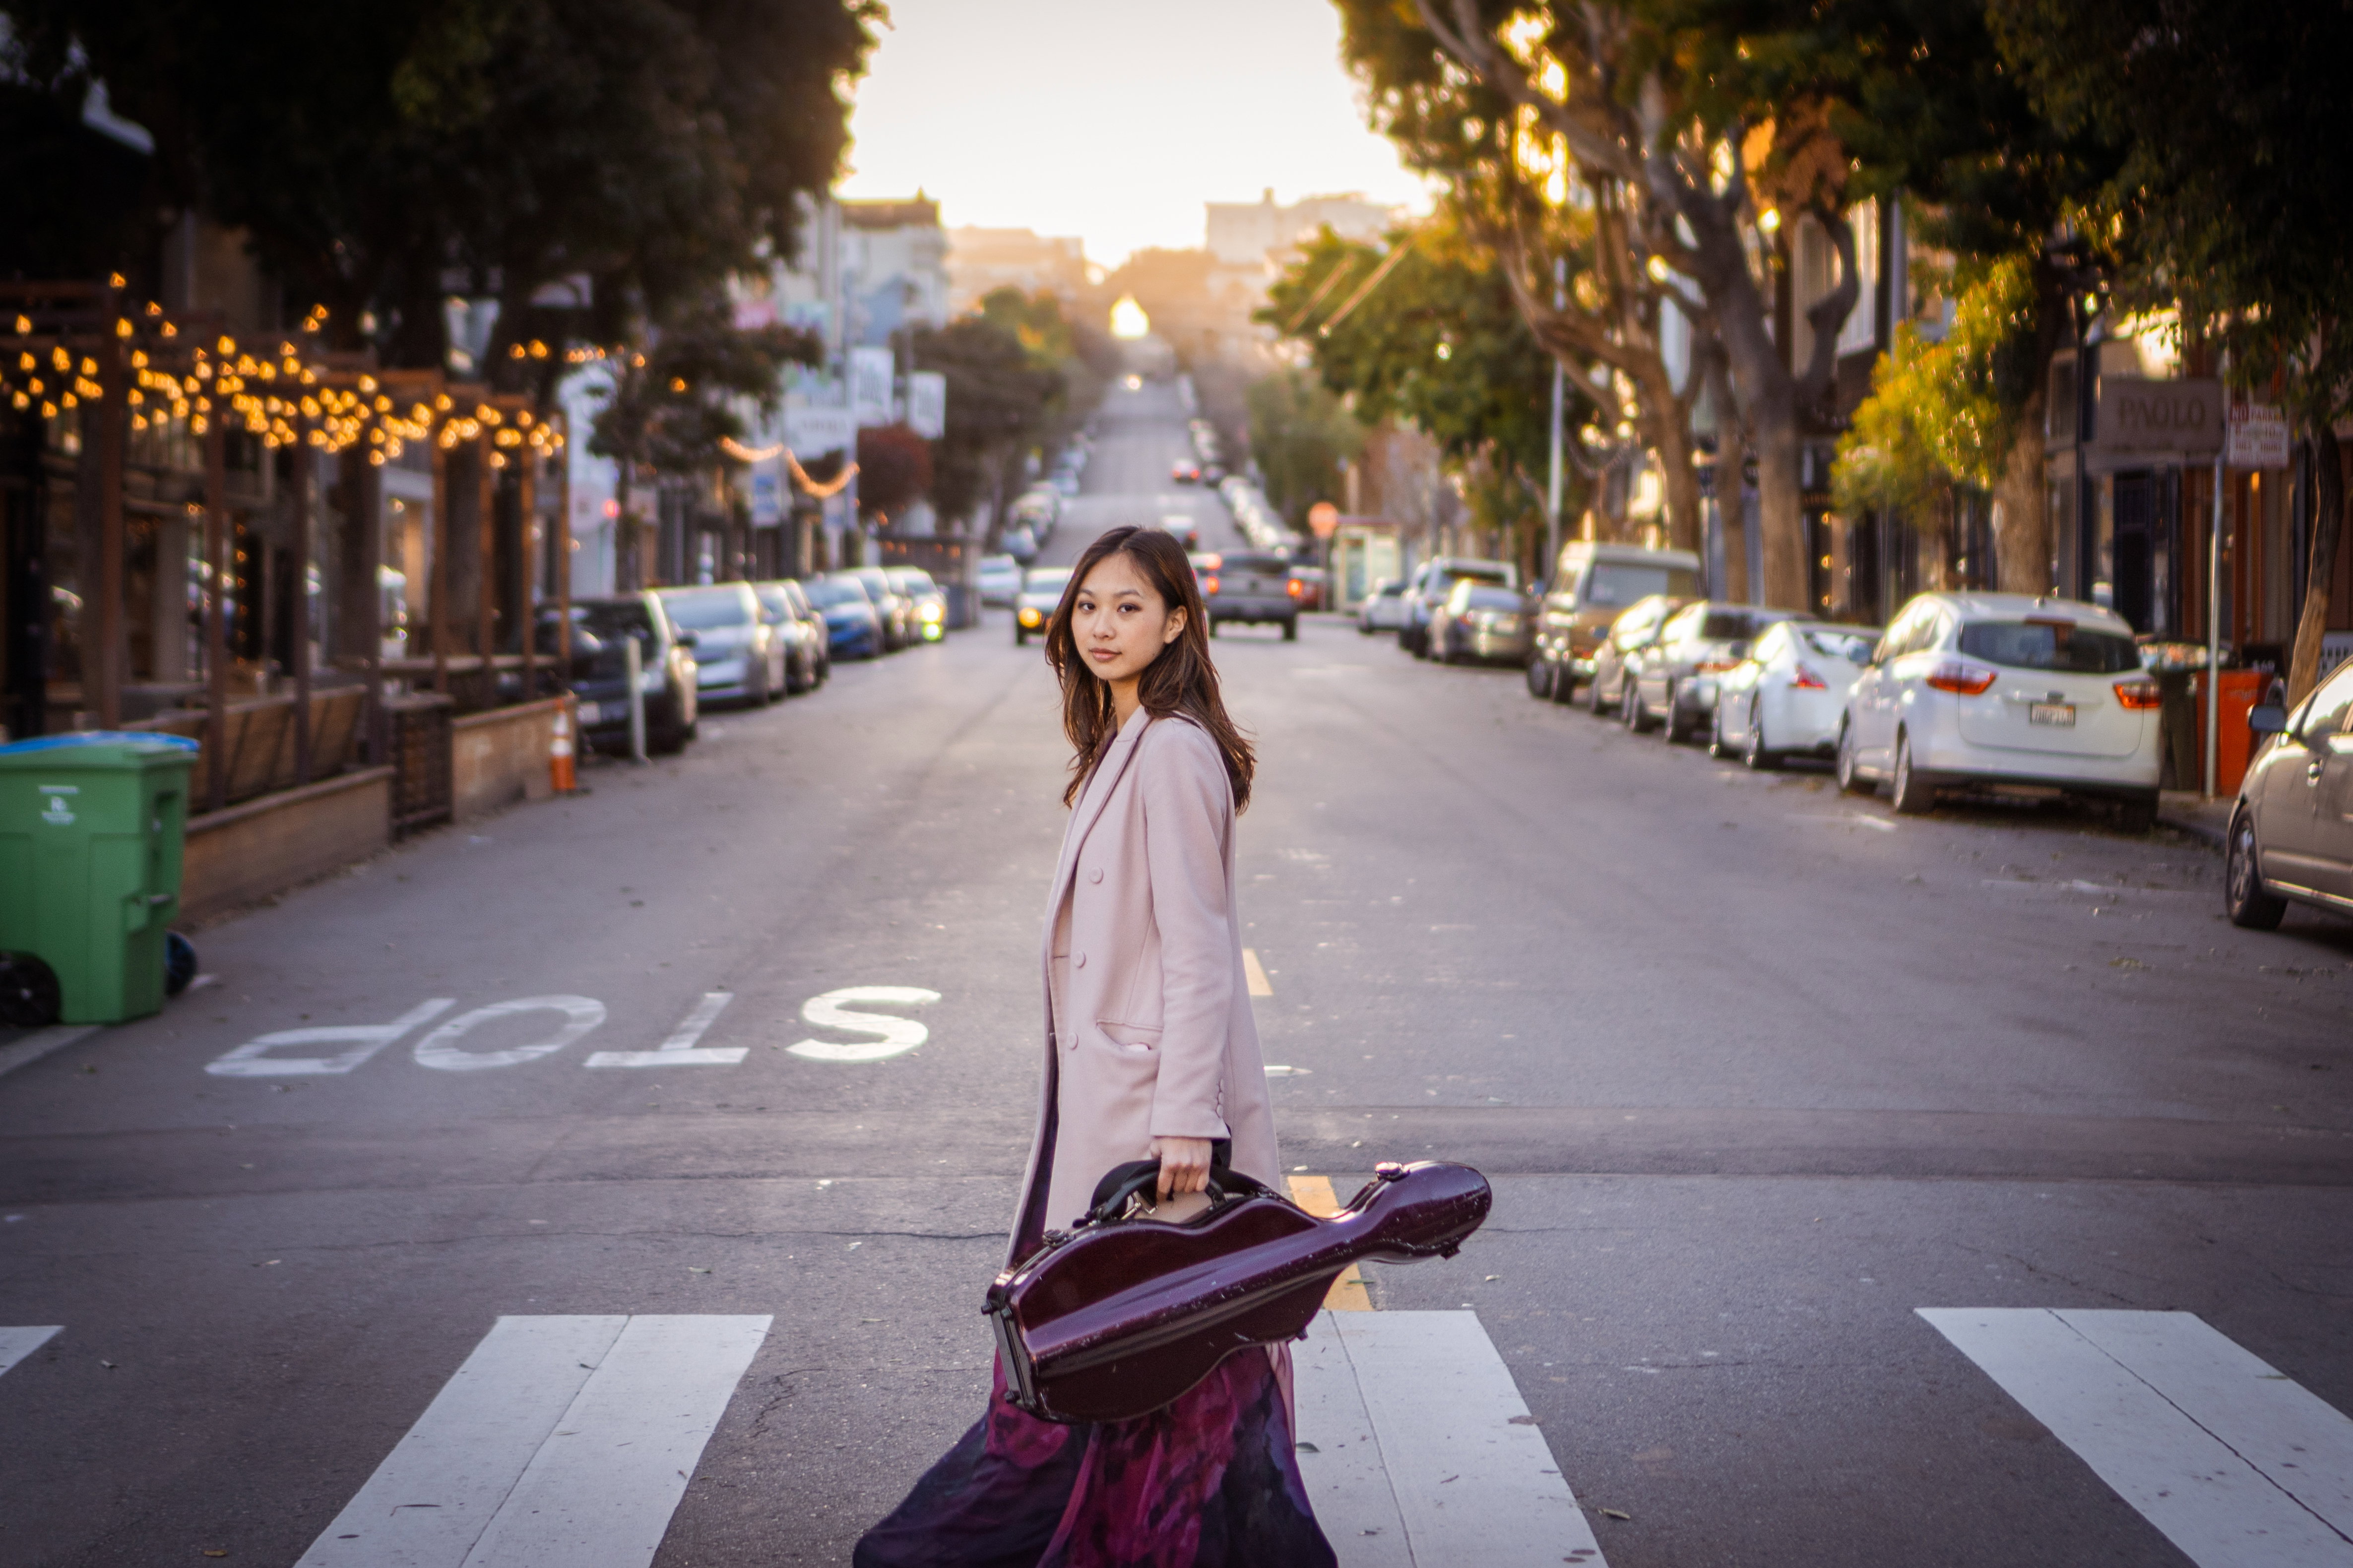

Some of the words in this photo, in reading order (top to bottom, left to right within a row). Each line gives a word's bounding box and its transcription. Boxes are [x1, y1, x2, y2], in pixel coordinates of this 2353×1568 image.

[2119, 396, 2206, 431] PAOLO
[2232, 405, 2247, 421] NO
[2251, 408, 2284, 422] PARK
[204, 985, 942, 1077] STOP
